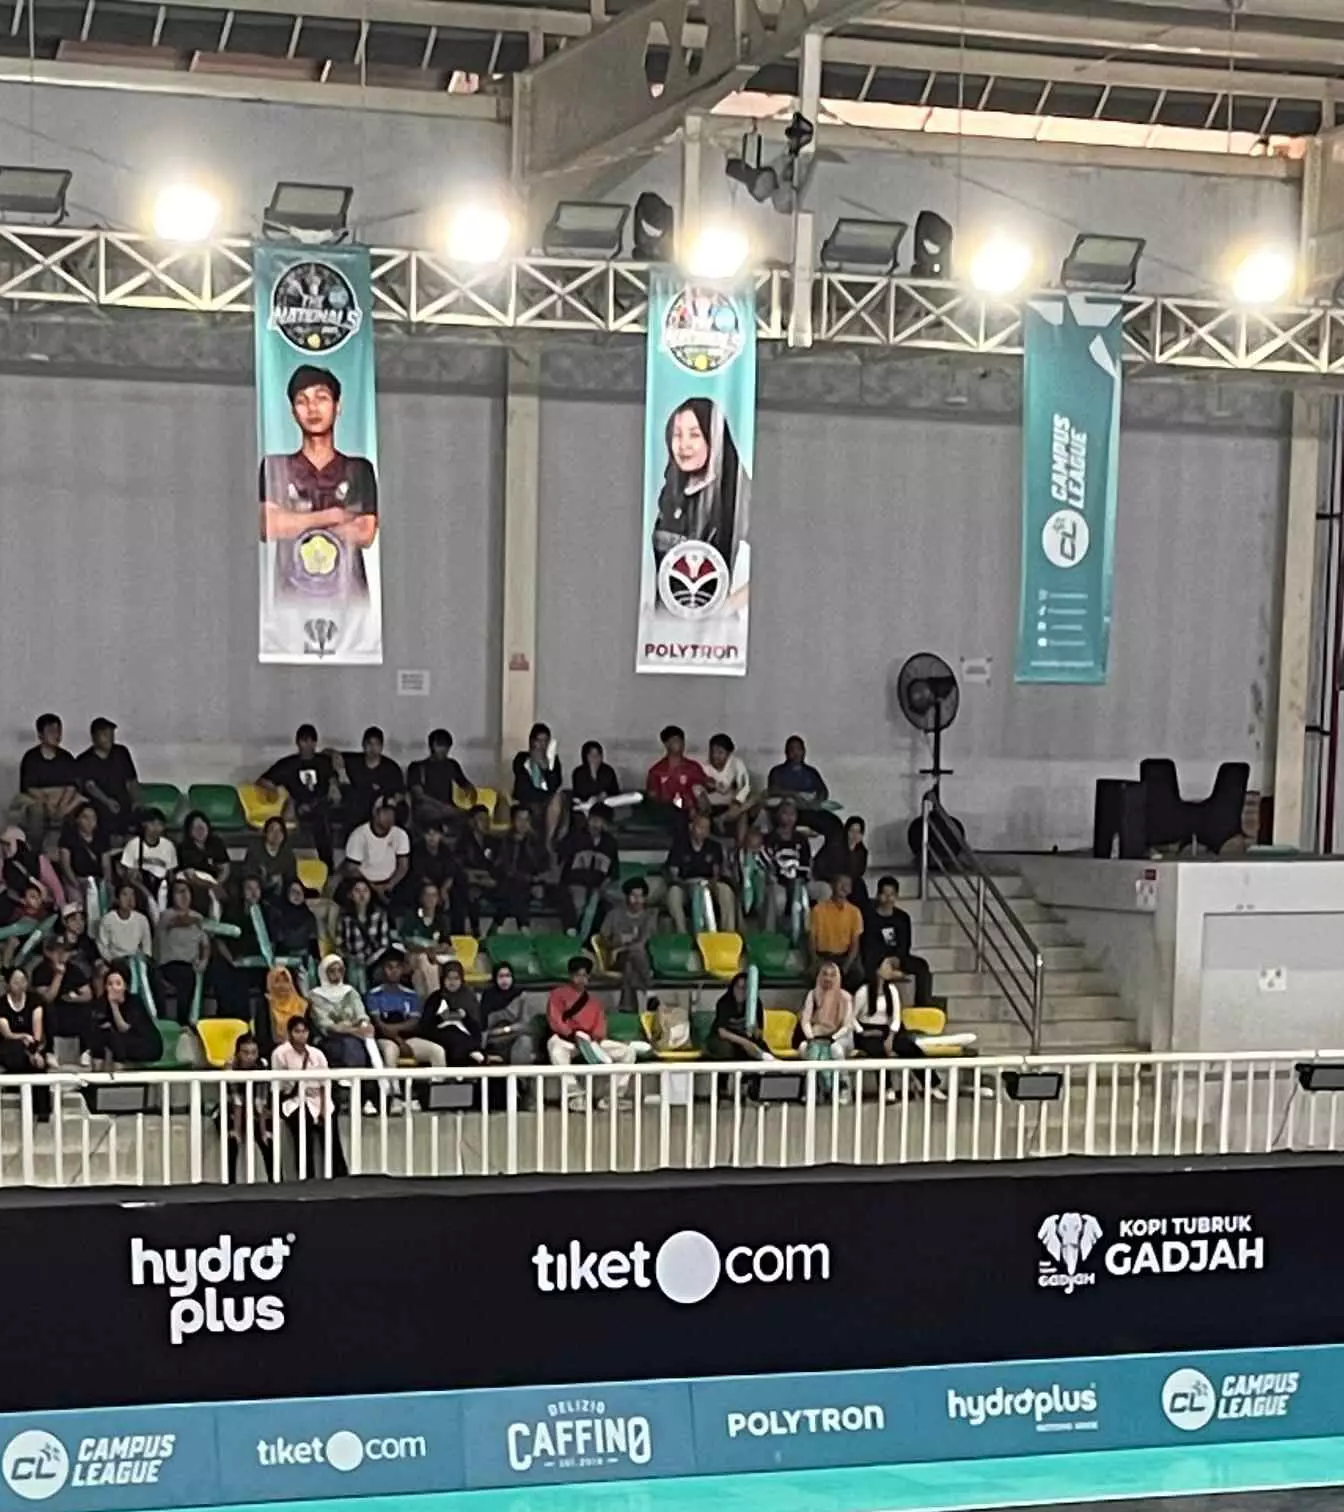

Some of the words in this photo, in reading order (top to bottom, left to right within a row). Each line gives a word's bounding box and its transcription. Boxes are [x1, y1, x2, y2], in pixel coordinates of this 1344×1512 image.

[1051, 413, 1071, 502] CAMPUS
[1068, 428, 1087, 510] LEAGUE
[644, 643, 738, 659] POLYTRON
[1119, 1219, 1167, 1237] KOPI
[1172, 1214, 1252, 1236] TUBRUK
[131, 1234, 290, 1298] hydro
[1104, 1237, 1264, 1276] GADJAH
[170, 1287, 285, 1345] plus
[1221, 1371, 1300, 1397] CAMPUS
[547, 1399, 606, 1417] DELIZIO
[727, 1404, 885, 1439] POLYTRON
[947, 1383, 1097, 1426] hydroplus
[1217, 1395, 1290, 1420] LEAGUE
[77, 1434, 176, 1462] CAMPUS
[507, 1415, 652, 1472] CAFFINO
[71, 1460, 163, 1488] LEAGUE
